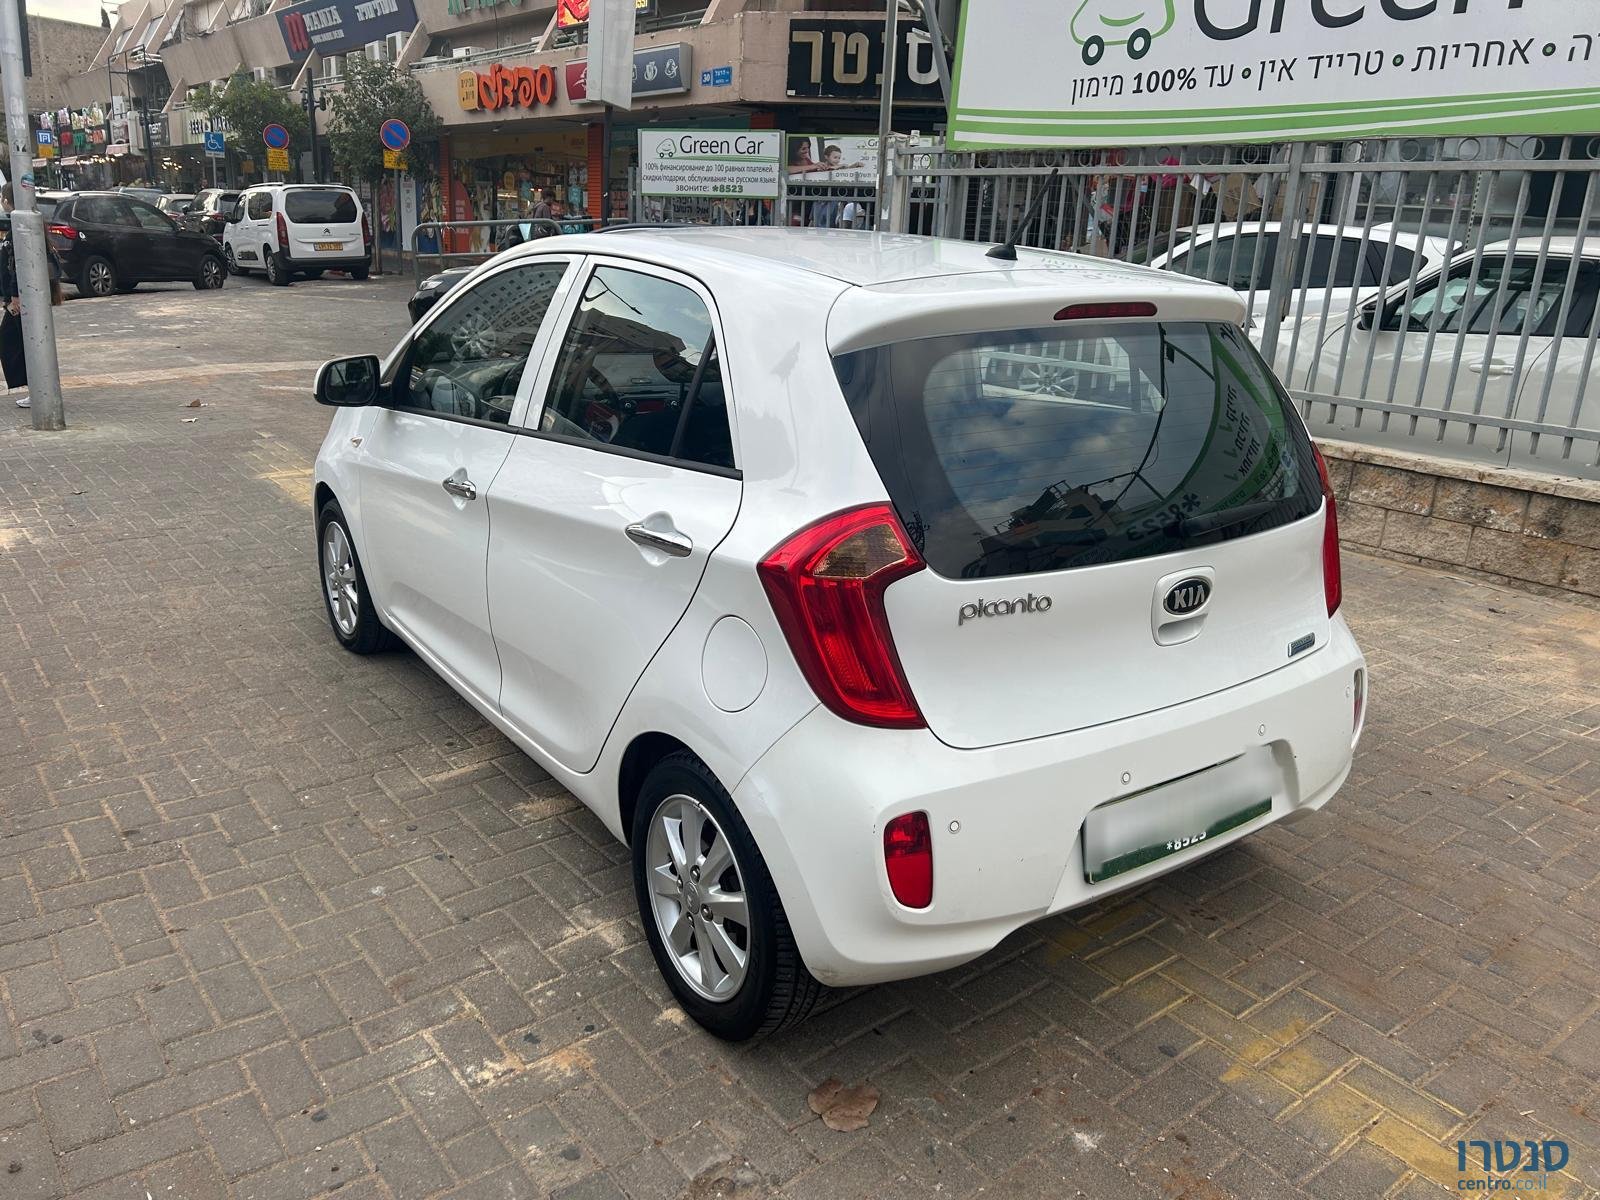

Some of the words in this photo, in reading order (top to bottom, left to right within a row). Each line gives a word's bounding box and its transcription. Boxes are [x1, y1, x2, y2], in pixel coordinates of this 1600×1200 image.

[302, 5, 342, 32] MANIA
[792, 30, 941, 85] סטר
[1307, 49, 1384, 79] טרייד
[1410, 37, 1535, 72] אחריות
[702, 72, 711, 83] 30
[1132, 66, 1197, 94] 100%
[1204, 63, 1235, 88] עד
[1257, 57, 1298, 91] אין
[1072, 73, 1124, 106] מימון
[679, 135, 730, 154] Green
[734, 135, 764, 155] Car
[644, 162, 659, 171] 100%
[659, 164, 705, 173] финансирование
[705, 165, 714, 173] до
[714, 164, 725, 172] 100
[687, 173, 728, 184] обслуживание
[675, 184, 710, 192] звоните:
[957, 592, 1053, 626] picanto
[1172, 584, 1206, 610] KIA
